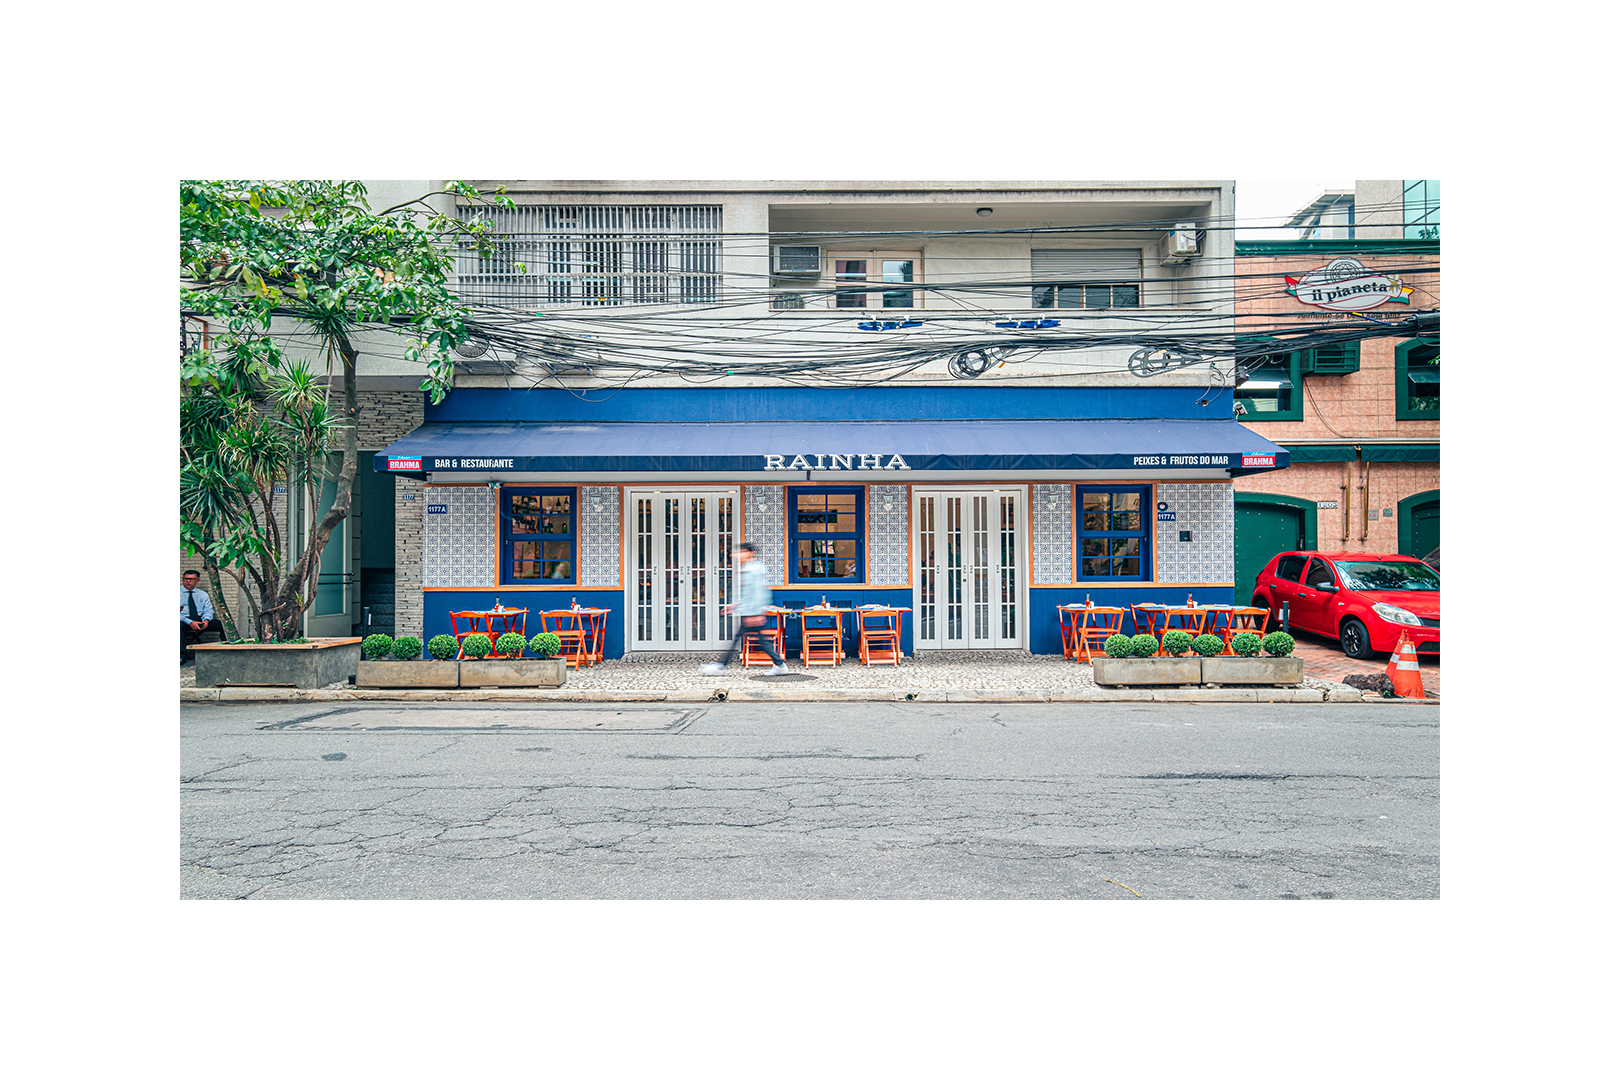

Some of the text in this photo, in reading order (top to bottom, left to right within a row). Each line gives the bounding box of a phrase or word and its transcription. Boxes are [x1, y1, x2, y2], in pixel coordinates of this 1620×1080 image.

[1326, 282, 1388, 302] pianeta
[390, 461, 420, 469] BRAHMA
[435, 459, 514, 468] BAR & RESTAURANTE
[763, 453, 912, 471] RAINHA
[1133, 456, 1229, 466] PEIXES & FRUTOS DO MAR
[1244, 458, 1273, 466] BRAHMA
